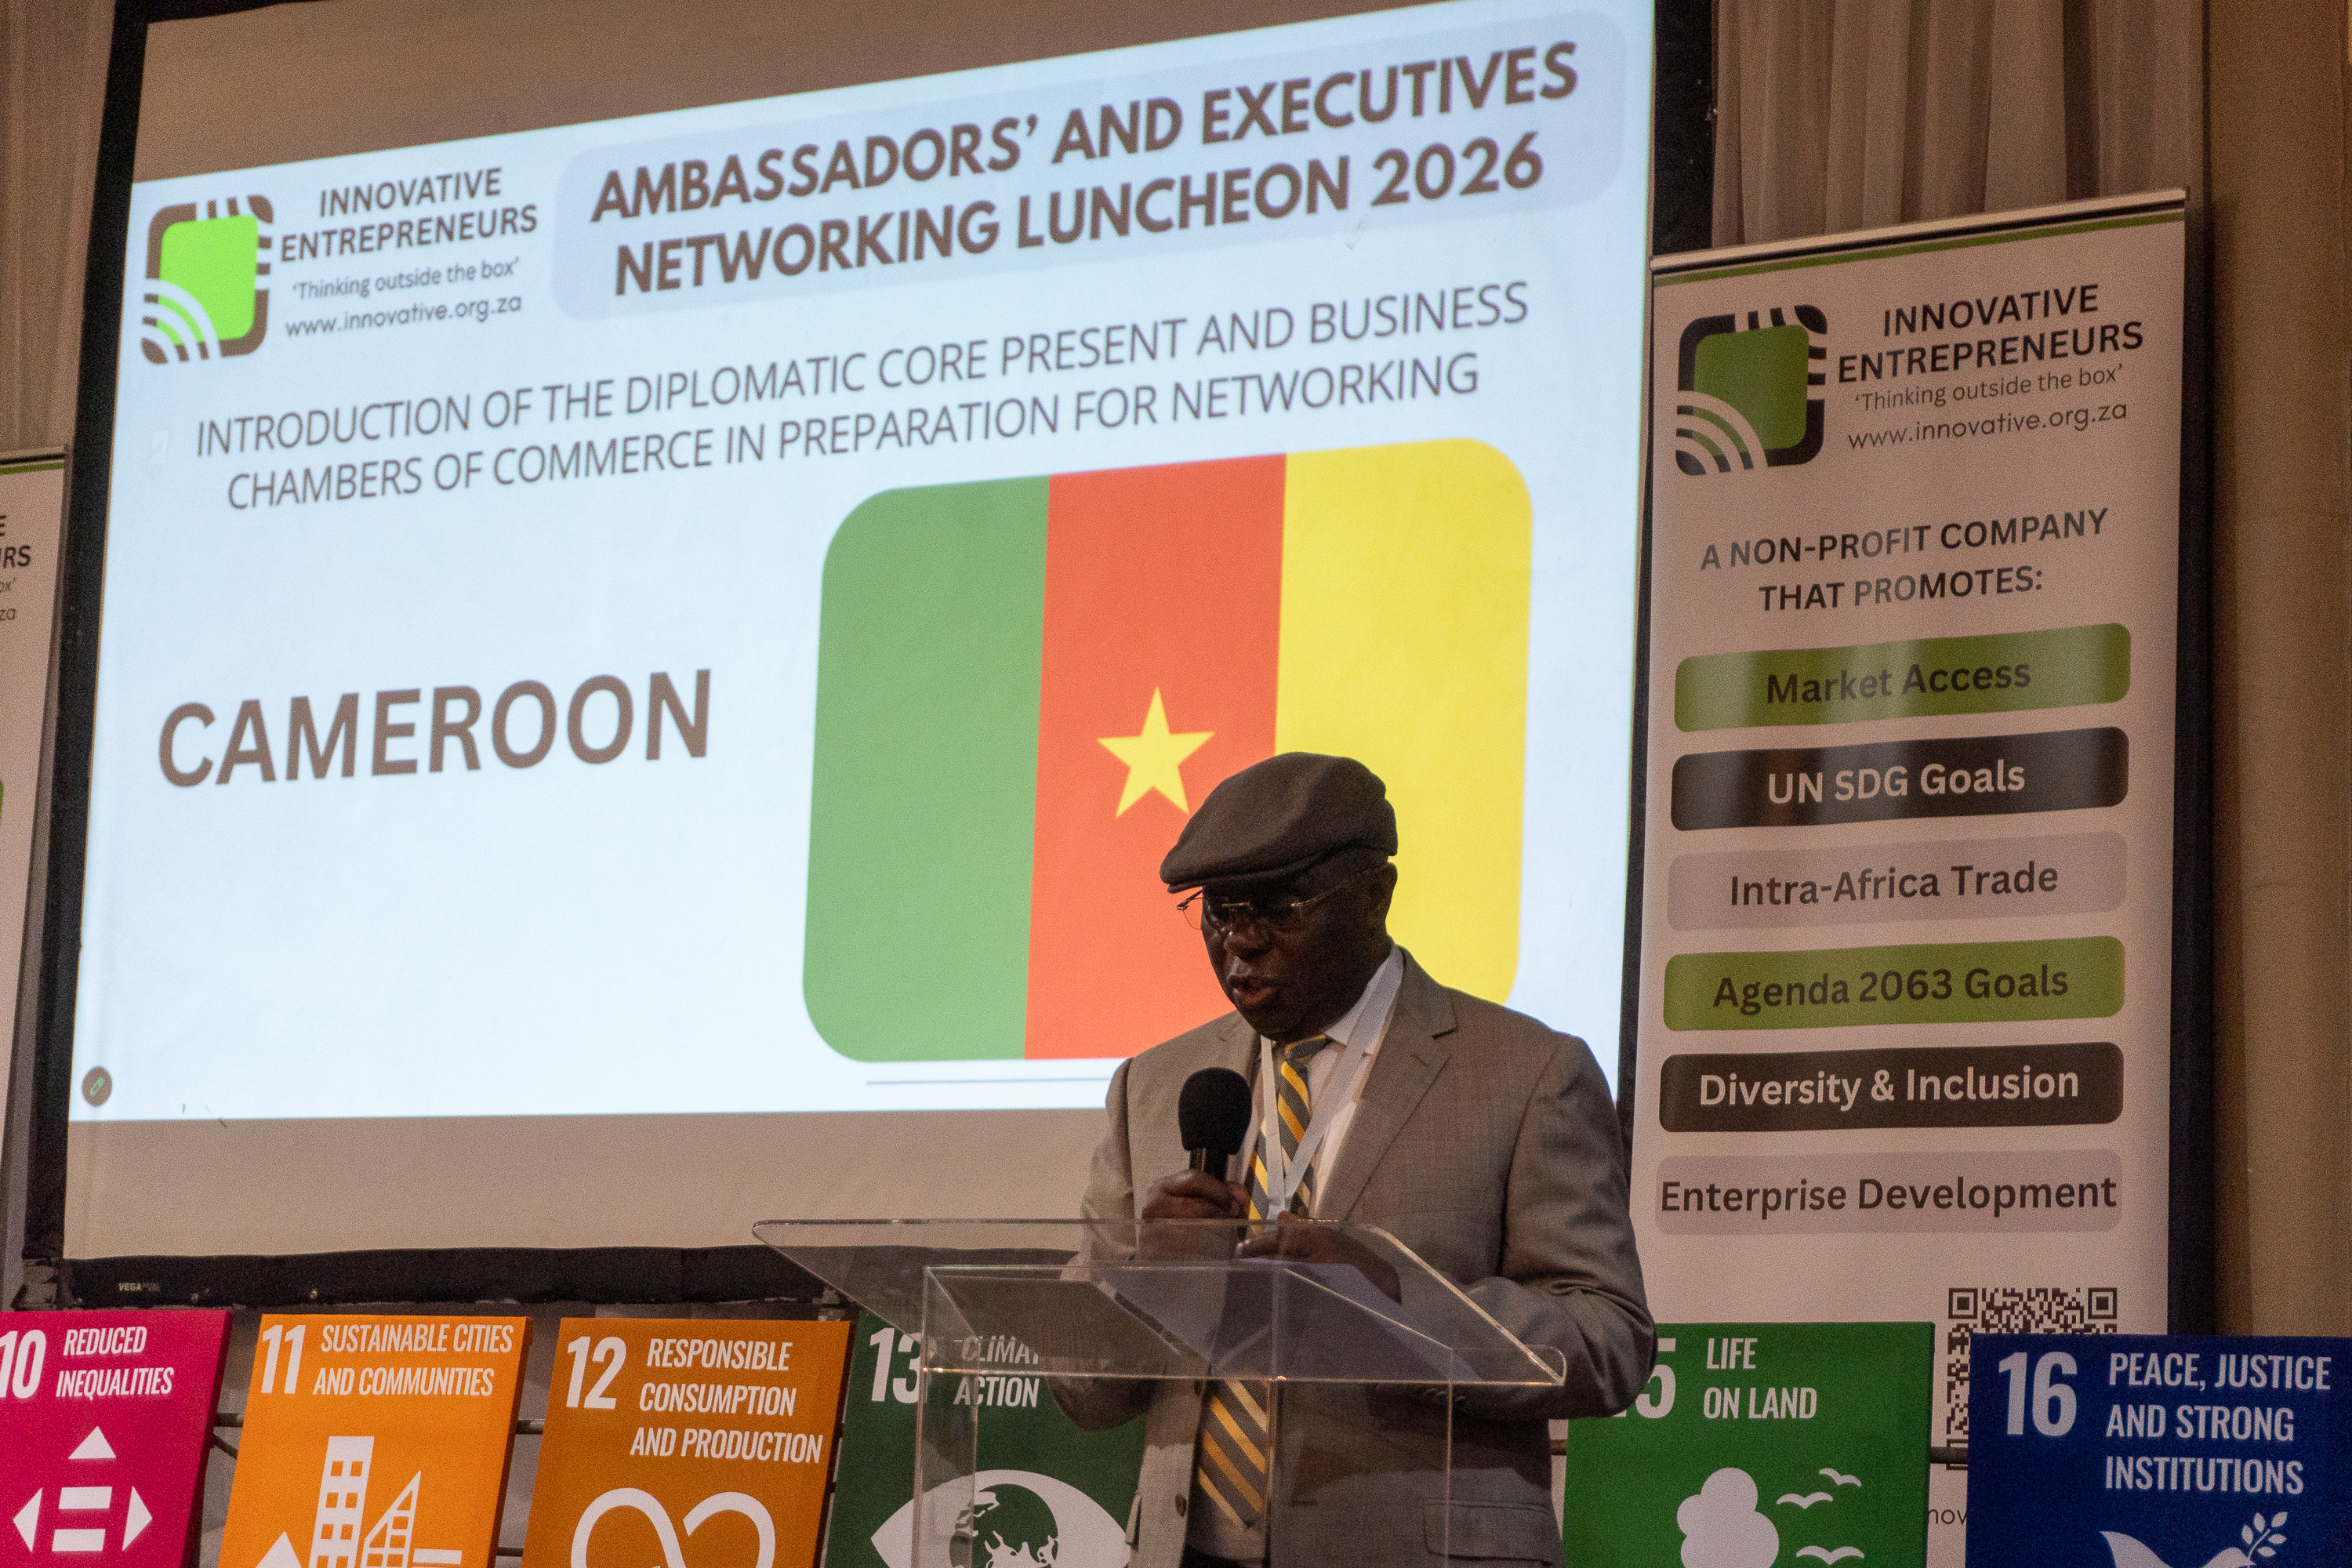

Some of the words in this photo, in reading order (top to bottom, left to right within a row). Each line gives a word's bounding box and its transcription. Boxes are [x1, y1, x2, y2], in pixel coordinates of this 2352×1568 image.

[1051, 96, 1183, 165] AND
[1202, 42, 1579, 145] EXECUTIVES
[319, 167, 502, 218] INNOVATIVE
[615, 200, 1000, 296] NETWORKING
[1018, 154, 1350, 249] LUNCHEON
[1370, 131, 1544, 207] 2026
[281, 205, 538, 263] ENTREPRENEURS
[375, 267, 441, 292] outside
[446, 263, 476, 282] the
[285, 296, 521, 337] www.innovative.org.za
[1883, 284, 2099, 337] INNOVATIVE
[197, 395, 470, 457] INTRODUCTION
[483, 388, 532, 427] OF
[543, 379, 614, 423] THE
[627, 353, 866, 414] DIPLOMATIC
[879, 340, 987, 386] CORE
[1001, 319, 1188, 375] PRESENT
[1197, 308, 1294, 355] AND
[1309, 281, 1529, 343] BUSINESS
[1838, 321, 2144, 383] ENTREPRENEURS
[1953, 376, 2031, 401] outside
[2038, 372, 2072, 392] the
[228, 458, 422, 510] CHAMBERS
[434, 452, 483, 490] OF
[493, 429, 713, 484] COMMERCE
[727, 424, 764, 463] IN
[780, 394, 1058, 459] PREPARATION
[1076, 386, 1157, 431] FOR
[1172, 352, 1479, 423] NETWORKING
[1849, 403, 2127, 449] www.innovative.org.za
[1700, 544, 1721, 570] A
[1730, 524, 1932, 568] NON-PROFIT
[1940, 507, 2109, 549] COMPANY
[1759, 583, 1845, 611] THAT
[1854, 565, 2043, 606] PROMOTES:
[1766, 668, 1893, 704] Market
[1901, 662, 2031, 695] Access
[159, 668, 711, 788] CAMEROON
[1768, 771, 1824, 804] UN
[1835, 765, 1908, 800] SDG
[1920, 758, 2026, 797] Goals
[1730, 866, 1940, 906] Intra-Africa
[1951, 861, 2059, 898] Trade
[1713, 972, 1850, 1016] Agenda
[1859, 969, 1953, 1004] 2063
[1965, 964, 2069, 1000] Goals
[1700, 1071, 1862, 1111] Diversity
[1871, 1069, 1894, 1102] &
[1907, 1065, 2079, 1101] Inclusion
[1661, 1178, 1847, 1220] Enterprise
[1858, 1176, 2117, 1218] Development
[64, 1327, 147, 1356] REDUCED
[260, 1324, 307, 1394] 11
[321, 1324, 448, 1352] SUSTAINABLE
[453, 1325, 514, 1352] CITIES
[647, 1338, 793, 1371] RESPONSIBLE
[961, 1334, 1039, 1365] CLIMA
[1706, 1338, 1758, 1370] LIFE
[0, 1330, 46, 1399] 10
[56, 1367, 174, 1401] INEQUALITIES
[313, 1368, 354, 1395] AND
[358, 1367, 495, 1396] COMMUNITIES
[566, 1336, 627, 1410] 12
[2109, 1354, 2206, 1390] PEACE,
[2214, 1356, 2332, 1389] JUSTICE
[639, 1383, 796, 1416] CONSUMPTION
[953, 1376, 1040, 1408] ACTION
[1704, 1387, 1740, 1418] ON
[1748, 1387, 1817, 1418] LAND
[1997, 1352, 2078, 1436] 16
[630, 1428, 676, 1456] AND
[681, 1429, 822, 1464] PRODUCTION
[2106, 1406, 2165, 1438] AND
[2175, 1406, 2295, 1441] STRONG
[2105, 1457, 2303, 1494] INSTITUTIONS
